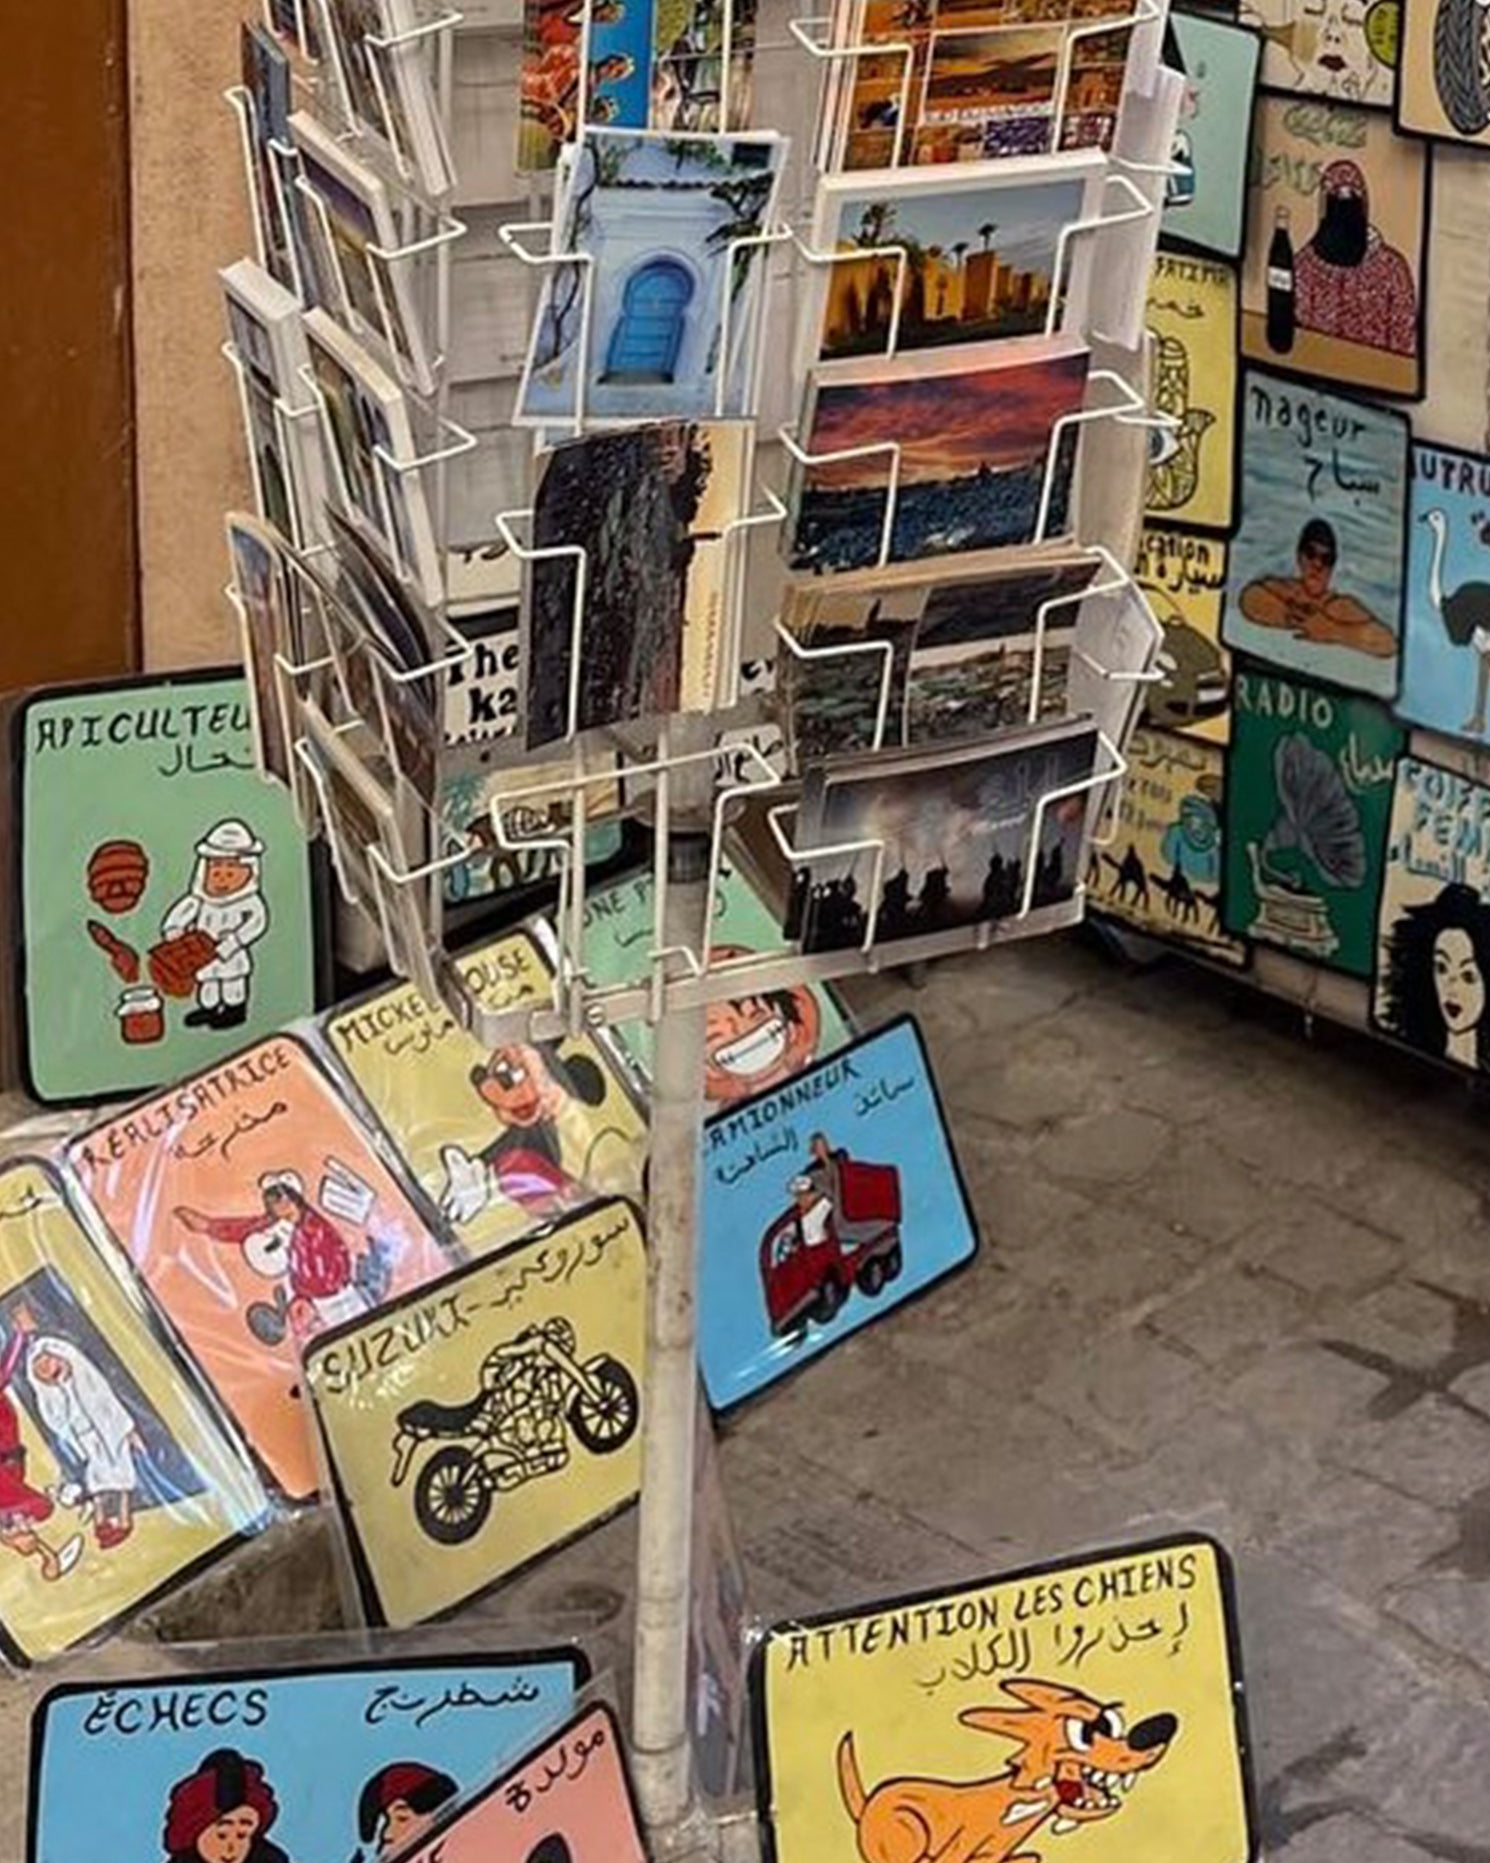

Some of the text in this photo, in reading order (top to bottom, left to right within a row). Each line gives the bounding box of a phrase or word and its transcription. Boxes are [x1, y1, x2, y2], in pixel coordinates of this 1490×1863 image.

[36, 702, 252, 754] APICULTEU
[1235, 673, 1335, 730] RADIO
[465, 947, 532, 995] OUSE
[700, 1058, 860, 1151] AMIONNEUR
[785, 1553, 1197, 1671] ATTENTION LES CHIENS
